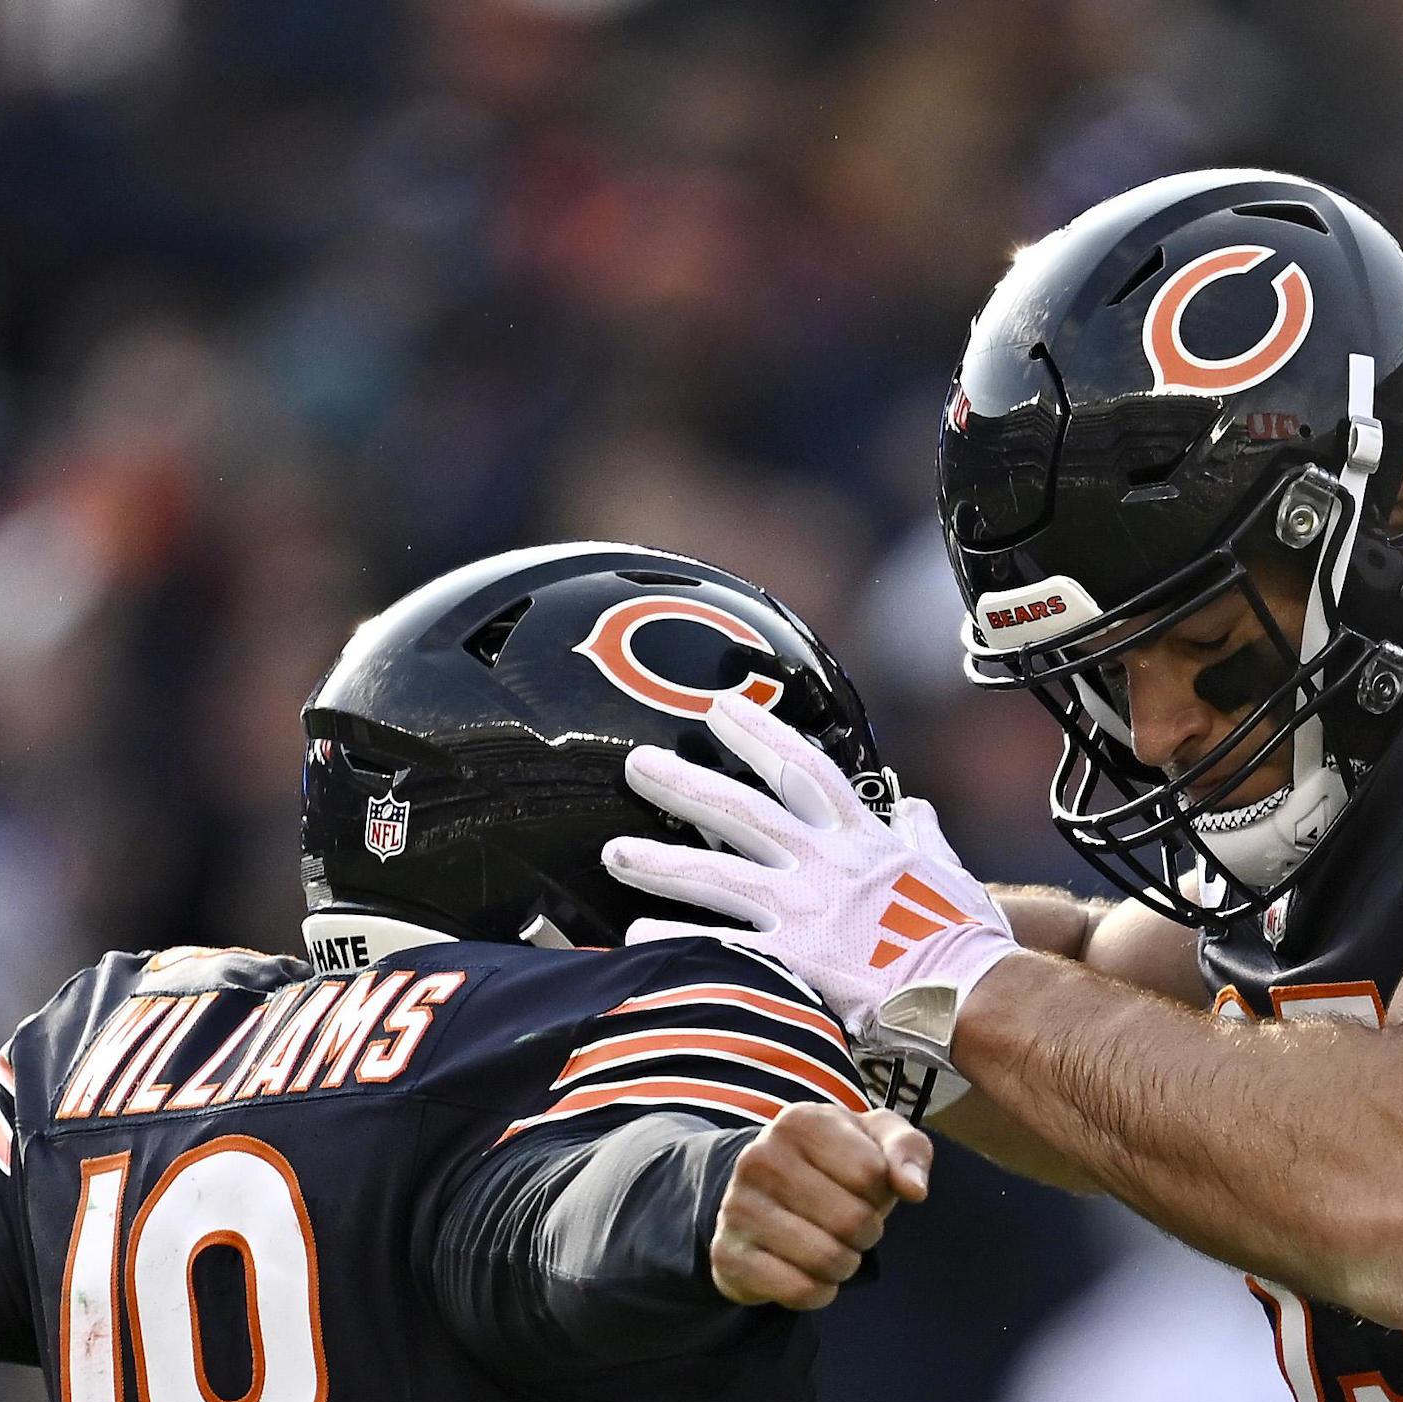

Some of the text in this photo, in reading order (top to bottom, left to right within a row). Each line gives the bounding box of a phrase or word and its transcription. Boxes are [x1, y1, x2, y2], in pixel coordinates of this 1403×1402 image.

[1142, 243, 1315, 397] C
[986, 595, 1067, 630] BEARS
[571, 594, 785, 721] C
[371, 821, 400, 850] NFL
[312, 935, 370, 974] HATE
[55, 970, 468, 1121] WILLIAMS
